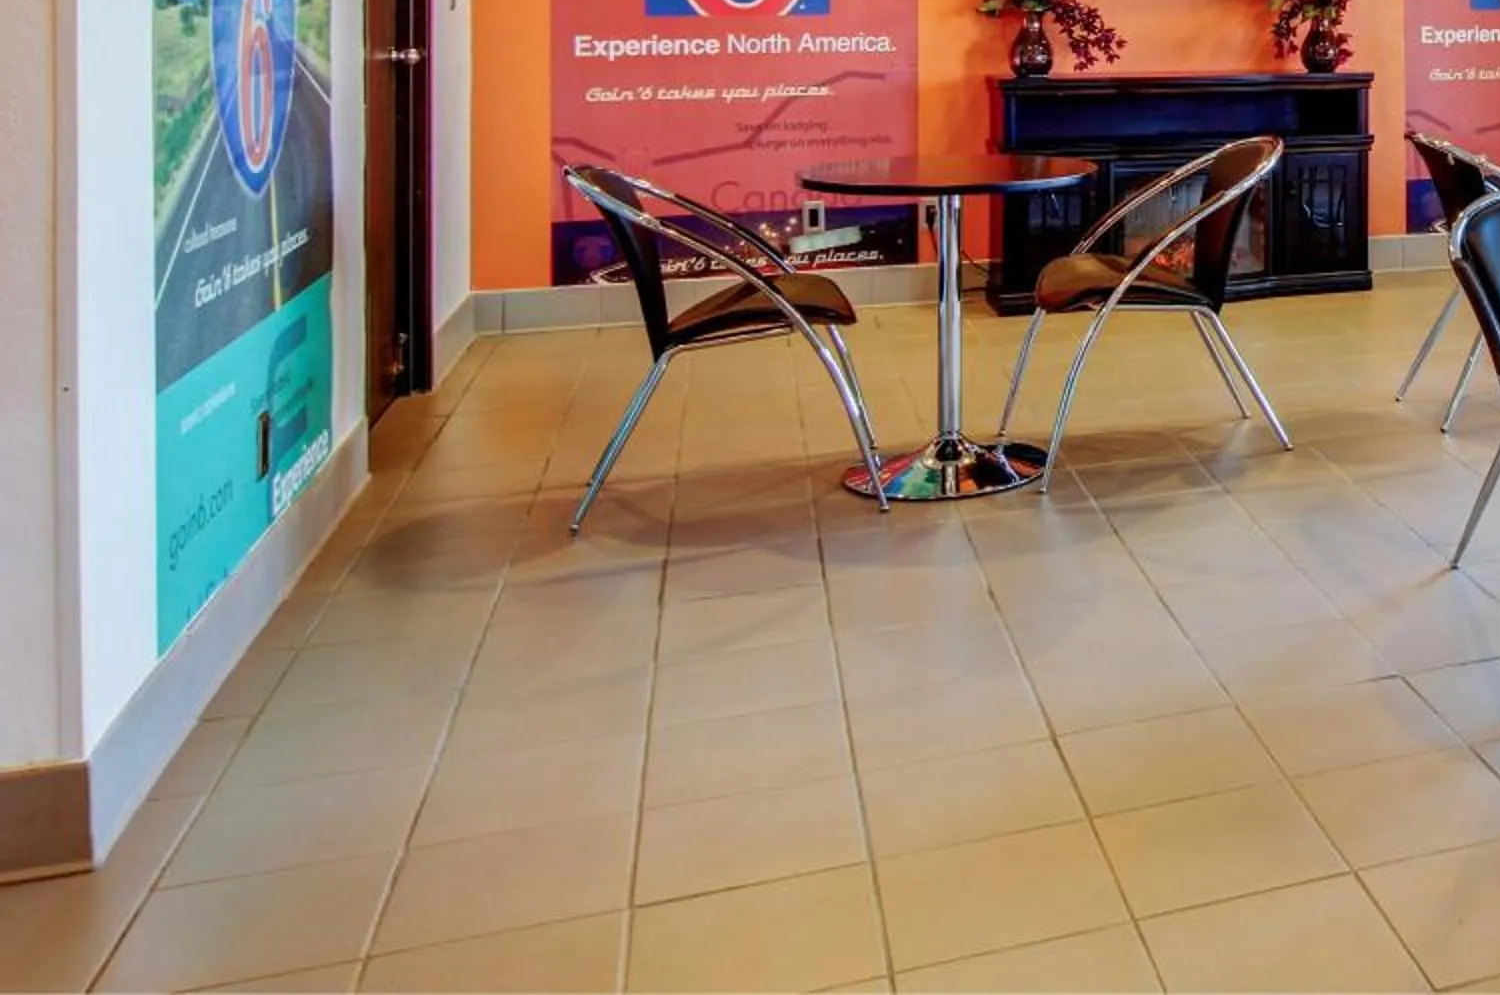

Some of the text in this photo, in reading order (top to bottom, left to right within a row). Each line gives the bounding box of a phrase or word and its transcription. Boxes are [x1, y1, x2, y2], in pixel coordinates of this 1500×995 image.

[574, 31, 897, 61] Experience North America.
[657, 86, 717, 101] takes
[720, 86, 760, 102] you
